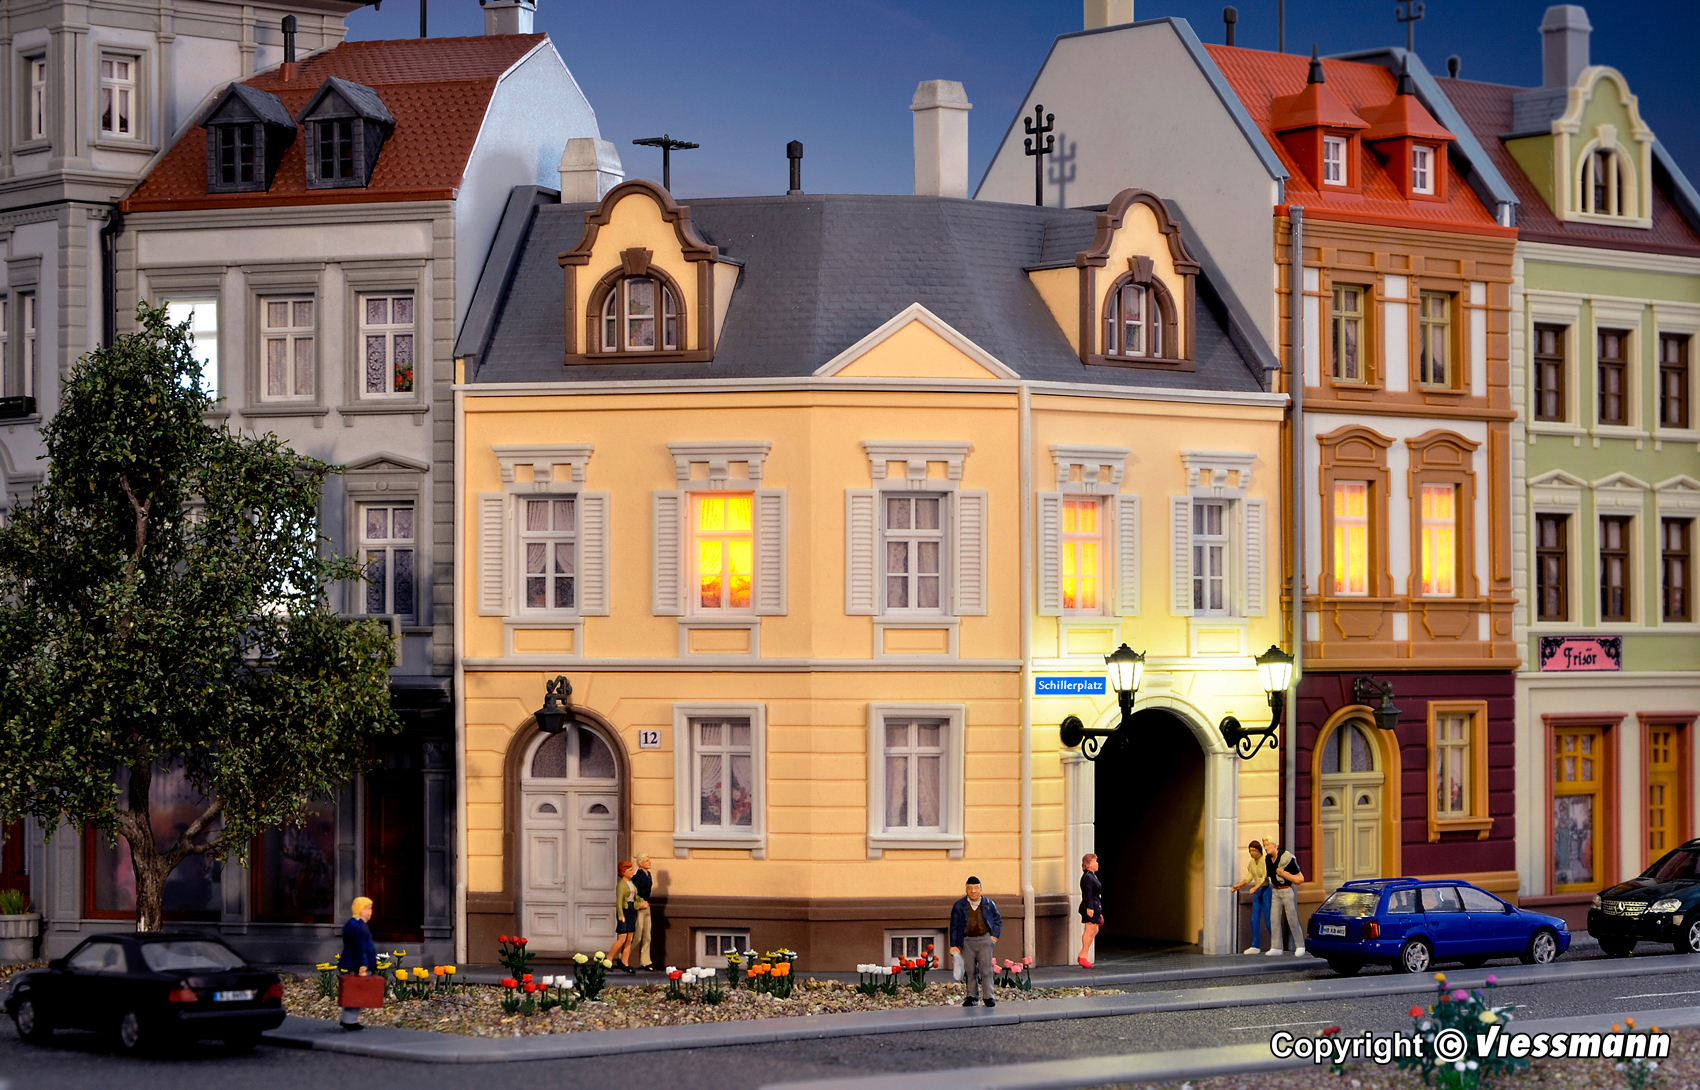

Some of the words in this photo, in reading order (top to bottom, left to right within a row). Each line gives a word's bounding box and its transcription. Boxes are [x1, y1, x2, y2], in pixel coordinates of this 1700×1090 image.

[1563, 647, 1597, 669] Frisör
[1038, 680, 1103, 693] Schillerplatz
[643, 731, 658, 745] 12
